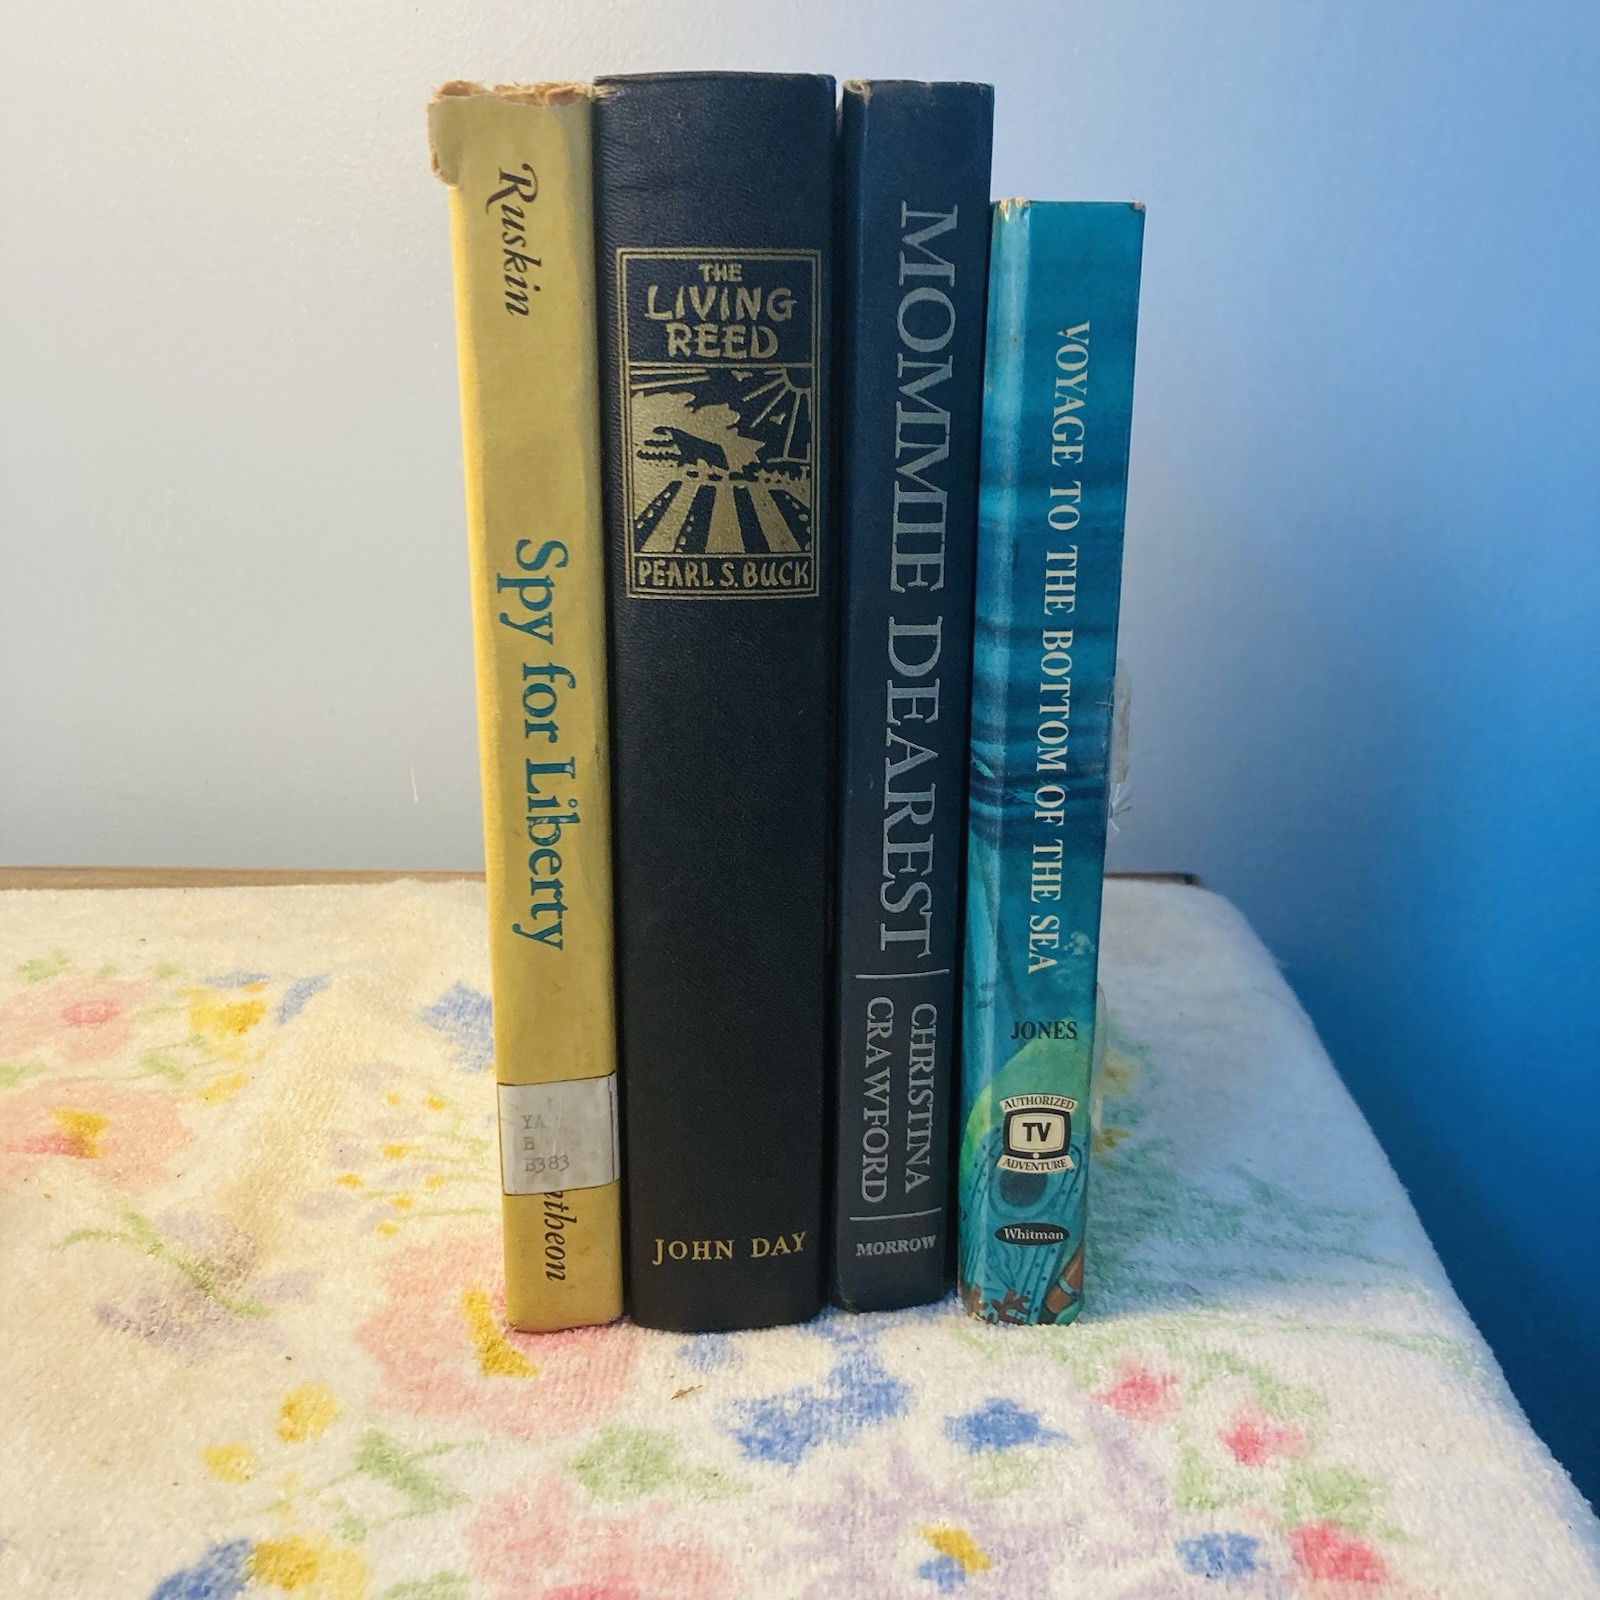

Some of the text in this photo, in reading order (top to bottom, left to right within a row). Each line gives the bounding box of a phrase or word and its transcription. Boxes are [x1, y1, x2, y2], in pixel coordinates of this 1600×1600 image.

[486, 162, 541, 317] Ruskin
[698, 263, 742, 282] THE
[644, 284, 797, 322] LIVING
[665, 322, 779, 360] REED
[638, 559, 809, 588] PEARL S. BUCK
[880, 199, 958, 959] MOMMIE DEAREST
[1027, 320, 1091, 974] VOYAGE TO THE BOTTOM OF THE SEA
[496, 538, 581, 950] Spy for Liberty
[1010, 1021, 1079, 1040] JONES
[860, 996, 895, 1204] CRAWFORD
[904, 1003, 938, 1194] CHRISTINA
[1003, 1096, 1075, 1110] AUTHORIZED
[522, 1136, 536, 1151] B
[1022, 1122, 1051, 1142] TV
[524, 1154, 570, 1174] B383
[1002, 1158, 1068, 1171] ADVENTURE
[855, 1234, 937, 1257] MORROW
[1003, 1226, 1065, 1240] Whitman
[652, 1231, 807, 1266] JOHN DAY
